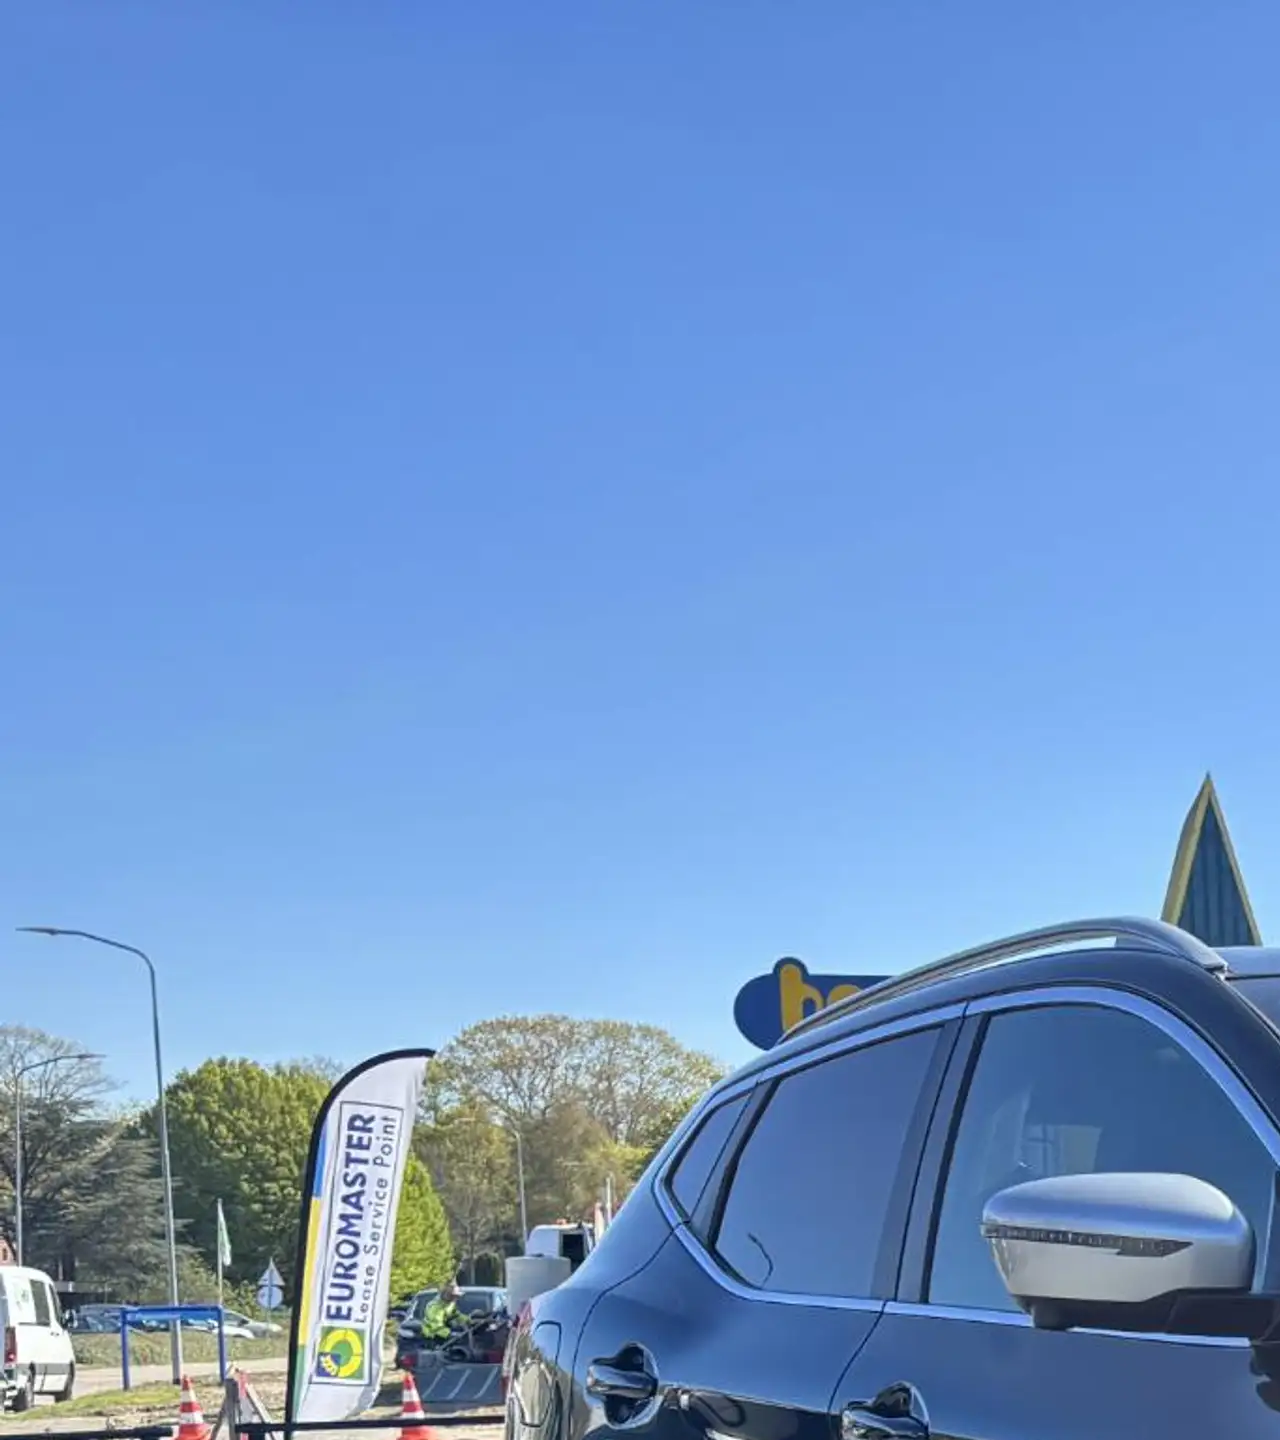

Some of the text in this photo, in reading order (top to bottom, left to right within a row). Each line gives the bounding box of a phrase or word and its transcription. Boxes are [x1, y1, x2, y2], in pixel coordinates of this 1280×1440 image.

[325, 1113, 376, 1322] EUROMASTER
[354, 1115, 397, 1324] Lease Service Point
